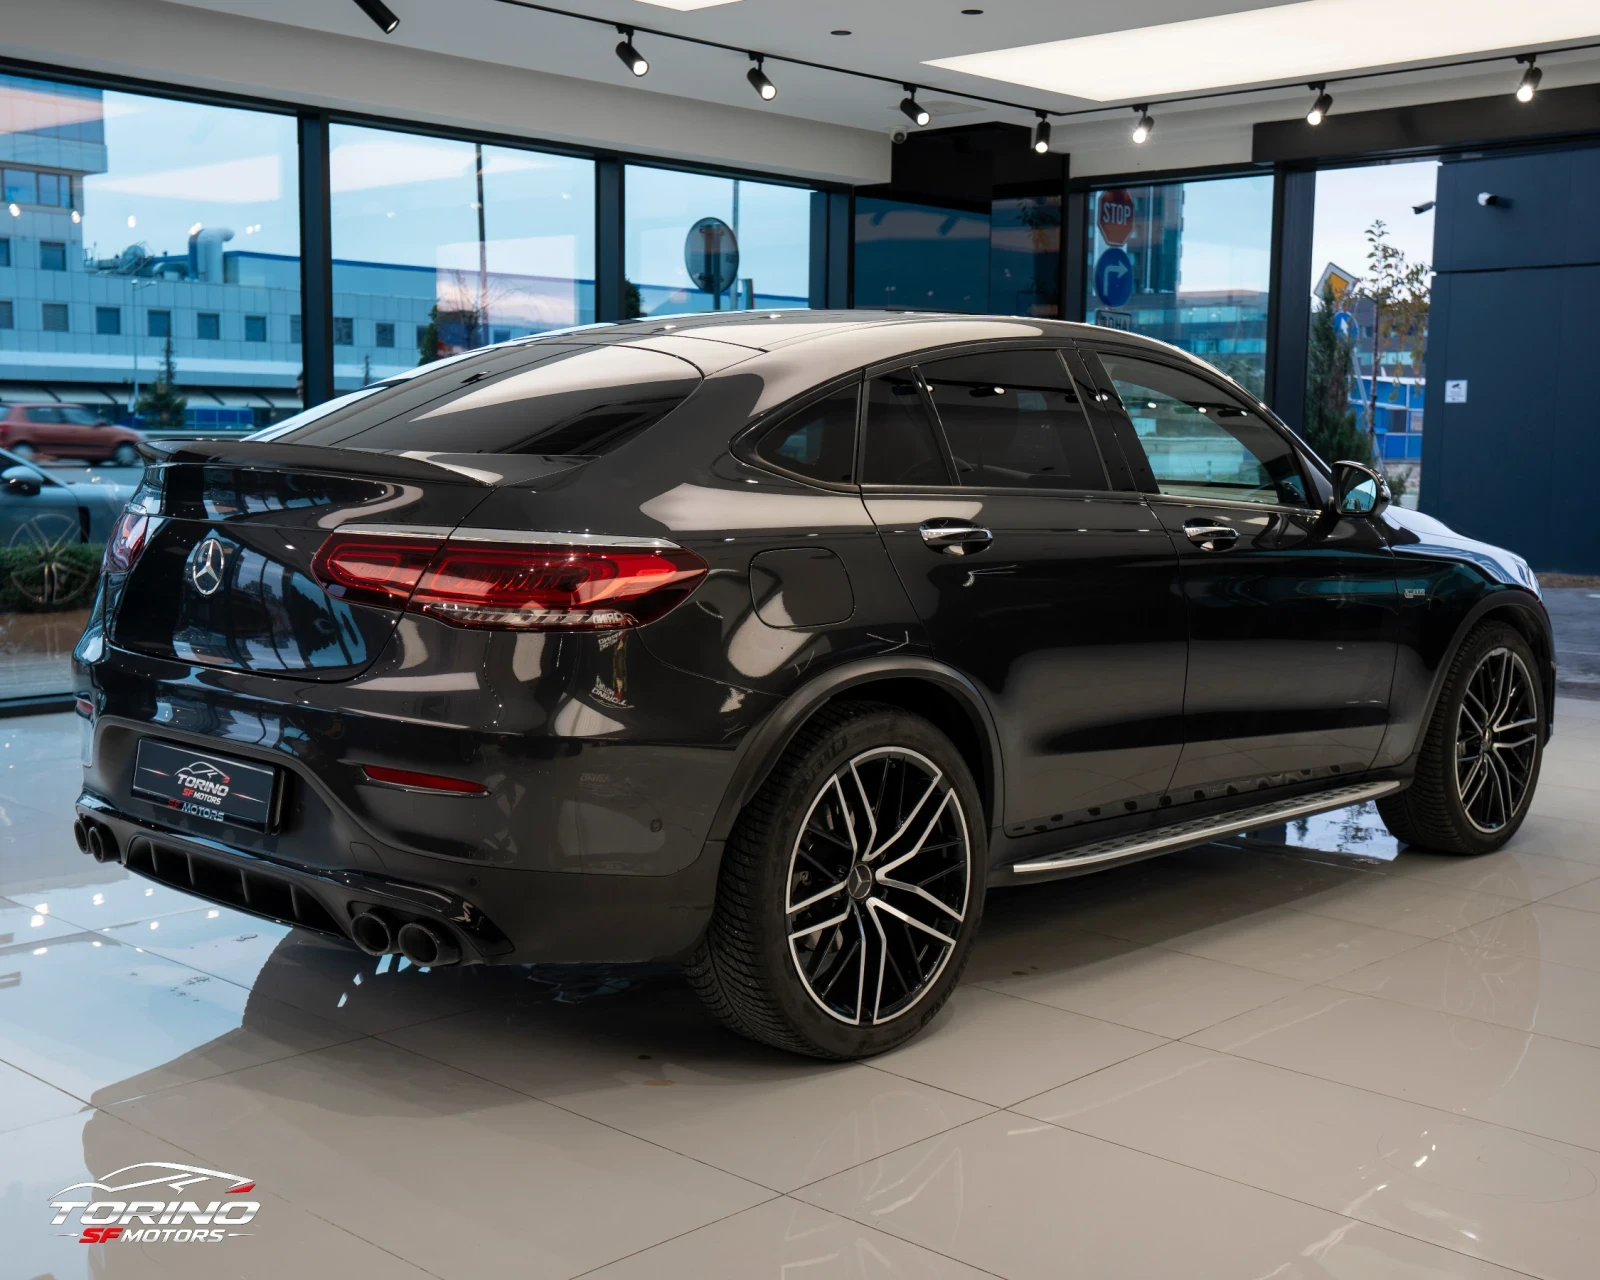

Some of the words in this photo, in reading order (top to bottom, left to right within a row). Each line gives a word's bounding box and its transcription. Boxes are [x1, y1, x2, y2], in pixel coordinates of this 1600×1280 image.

[1103, 202, 1131, 225] STOP
[177, 774, 229, 797] TORINO
[182, 788, 194, 797] SF
[193, 791, 221, 805] MOTORS
[181, 802, 225, 822] MOTORS
